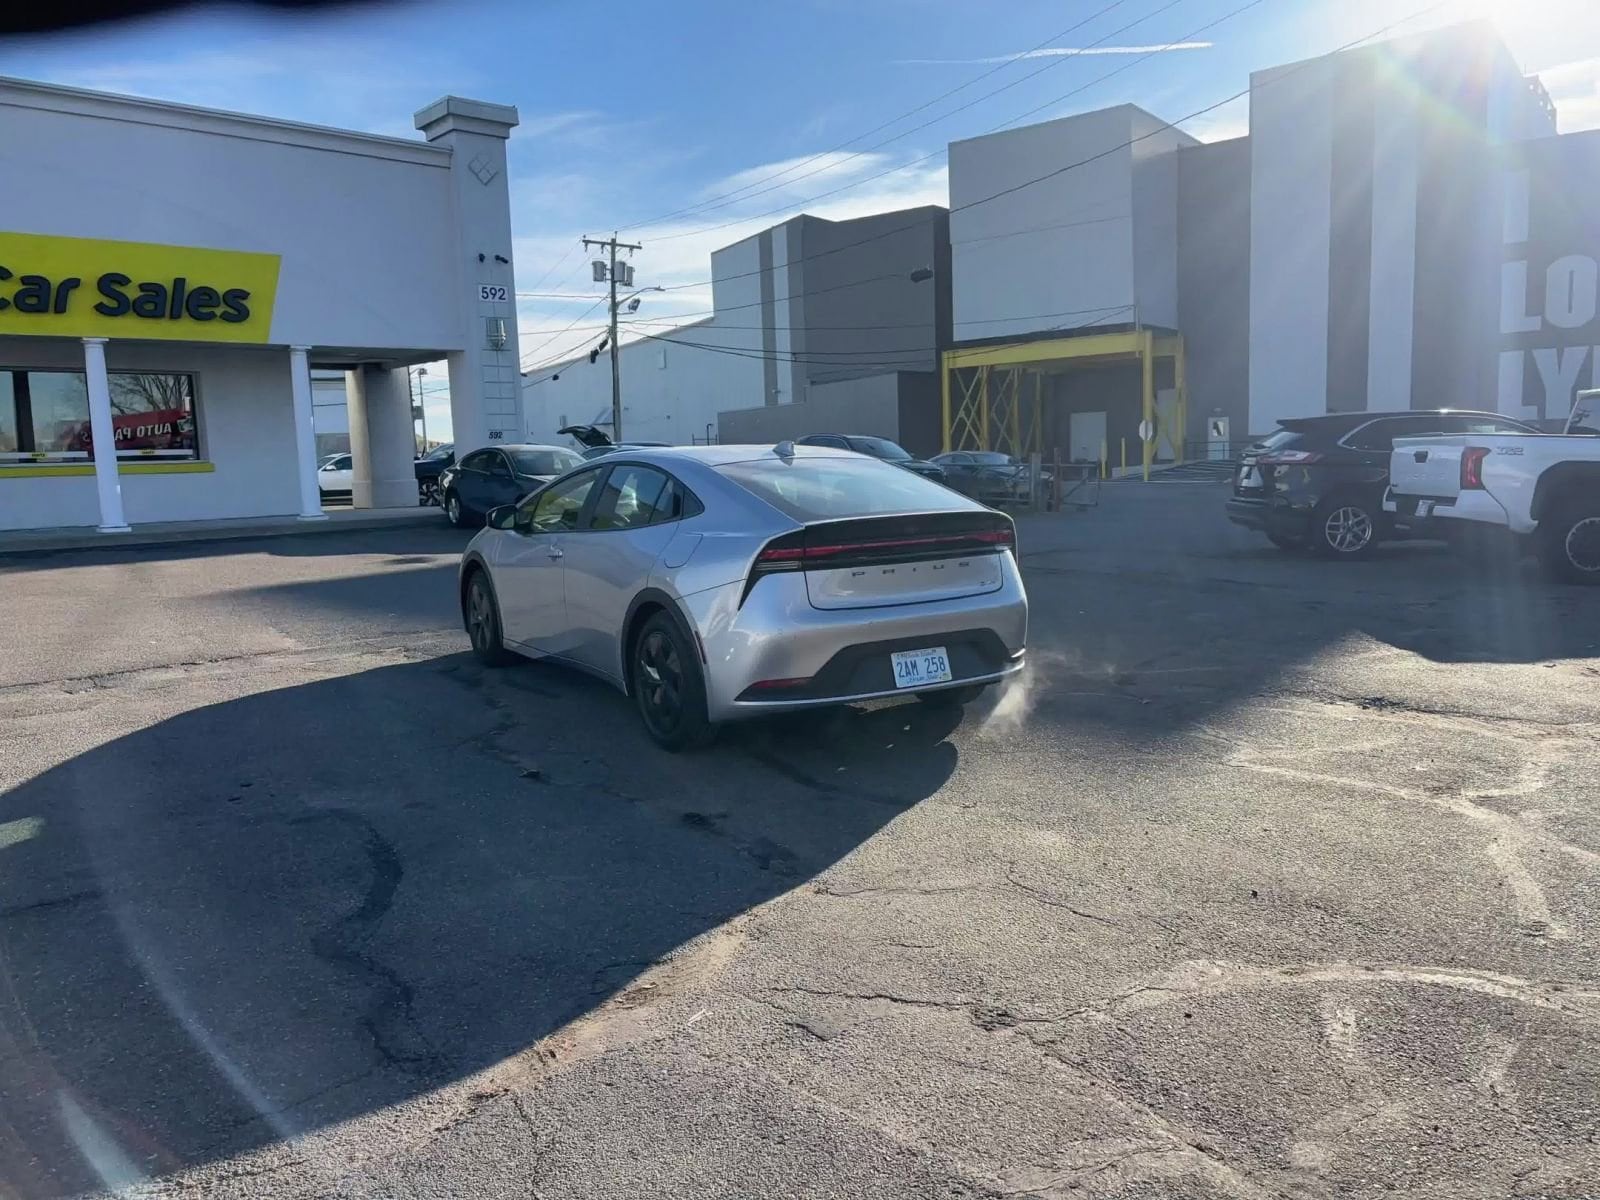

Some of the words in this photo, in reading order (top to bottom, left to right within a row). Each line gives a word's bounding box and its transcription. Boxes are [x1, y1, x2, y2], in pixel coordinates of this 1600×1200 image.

[94, 272, 251, 323] Sales
[481, 286, 506, 300] 592
[1500, 254, 1598, 334] LO
[1498, 345, 1600, 421] LY
[488, 431, 503, 440] 592
[896, 659, 919, 678] 2AM
[924, 656, 946, 674] 258
